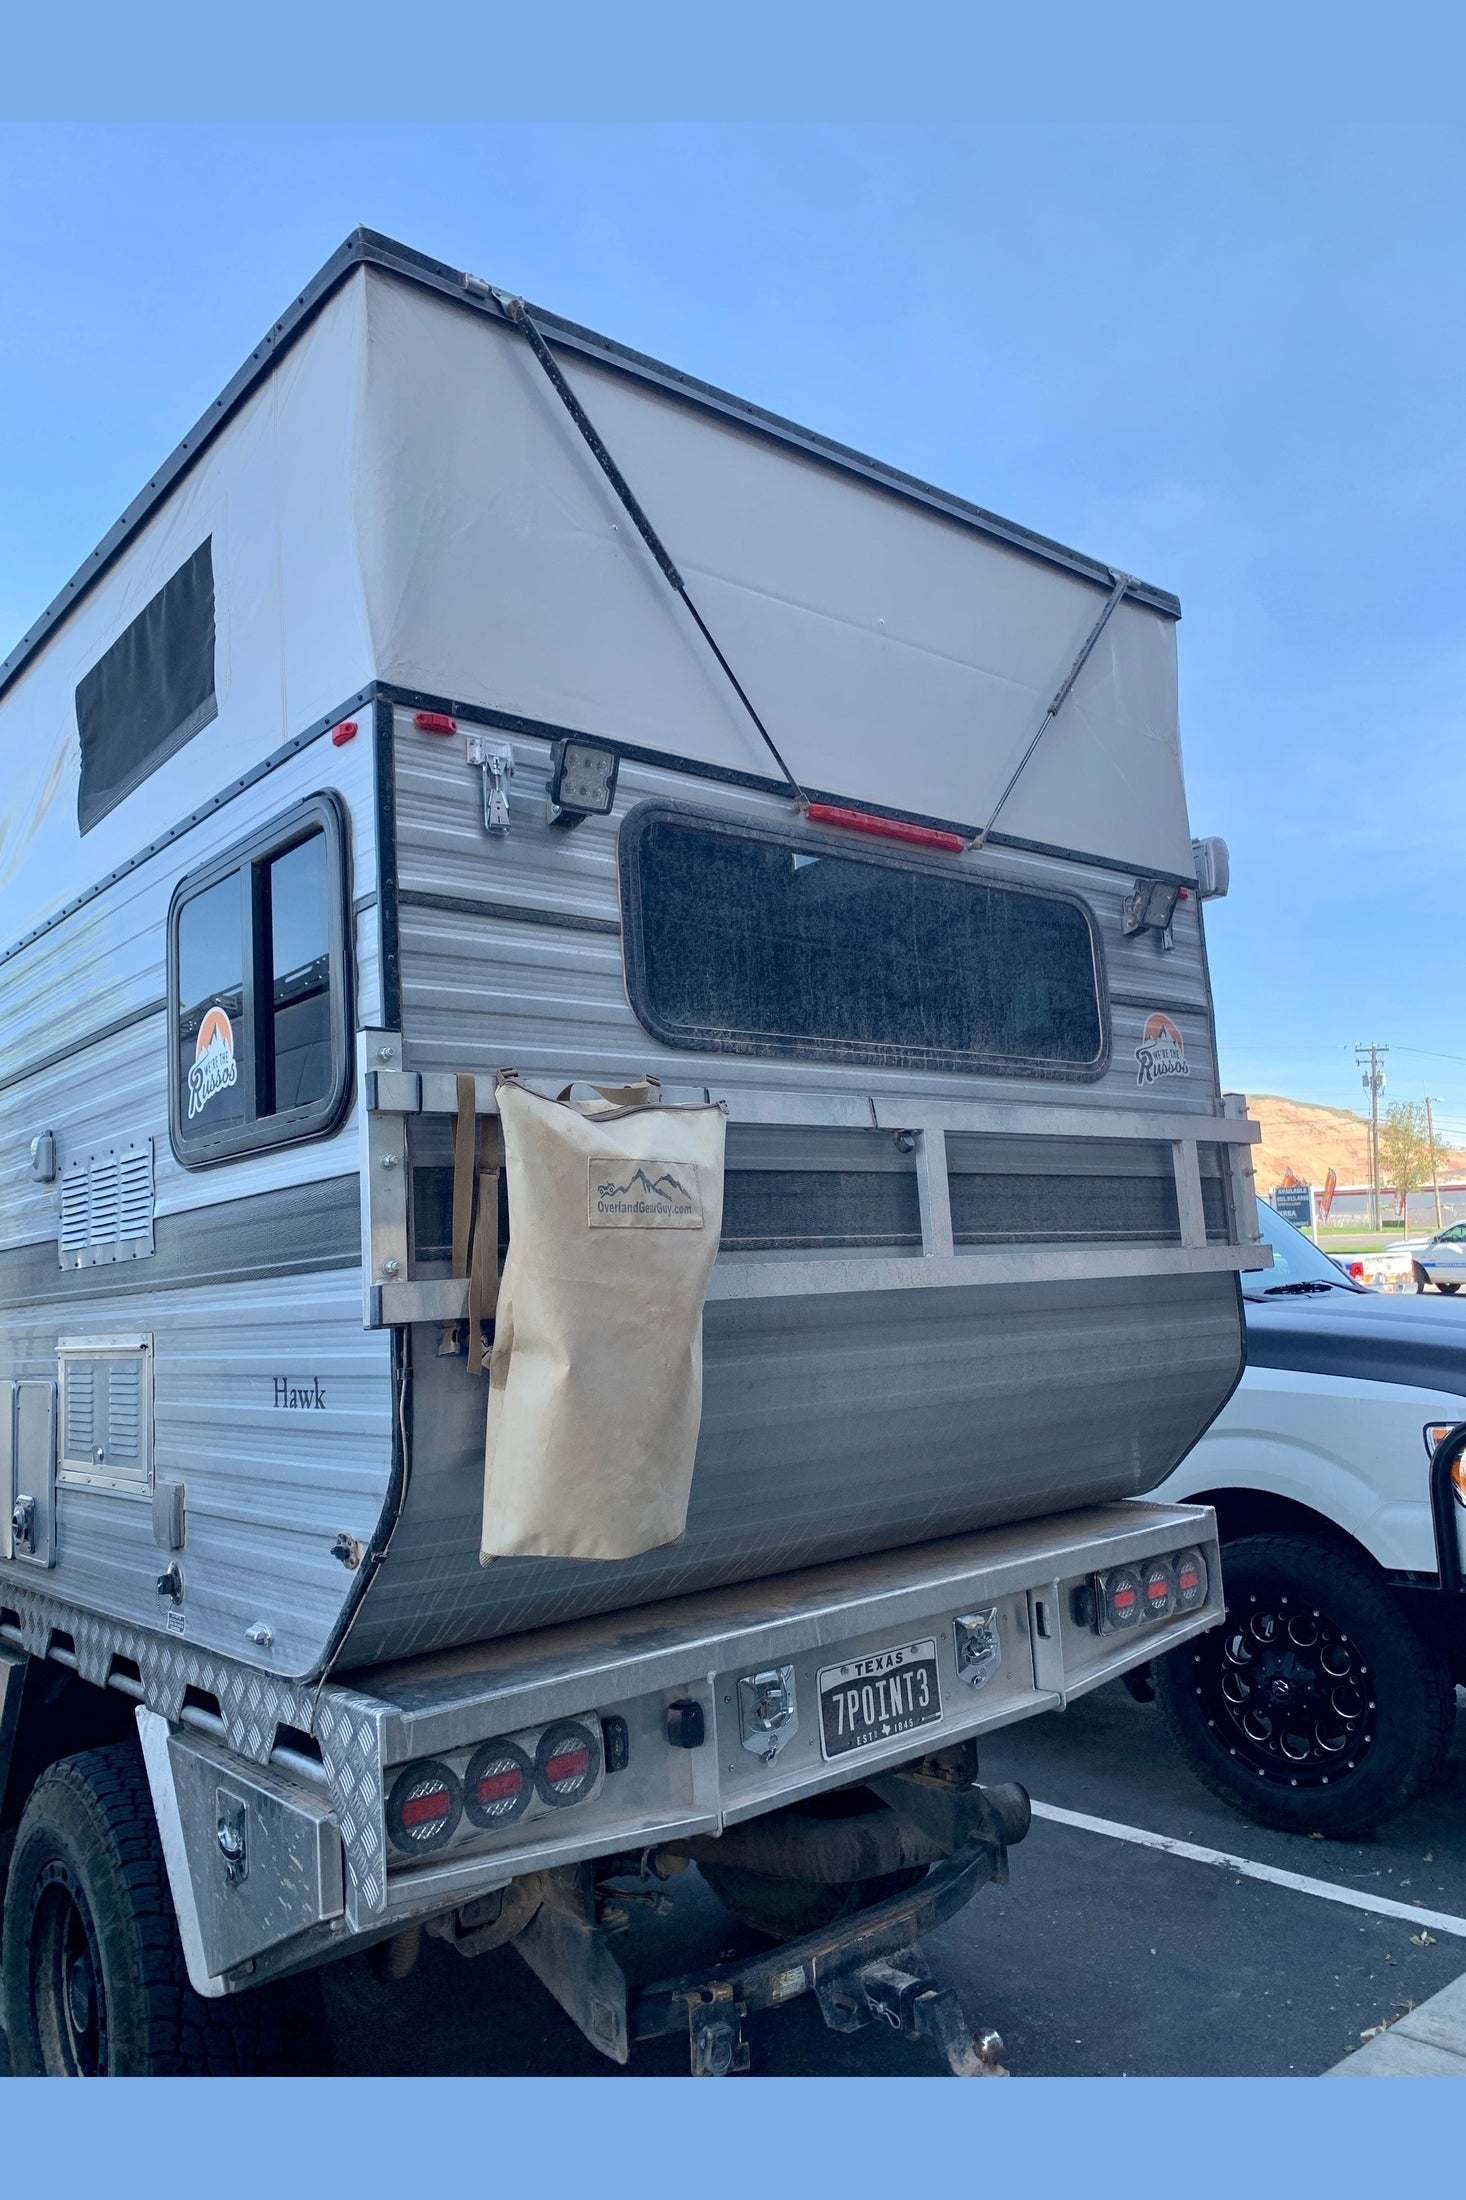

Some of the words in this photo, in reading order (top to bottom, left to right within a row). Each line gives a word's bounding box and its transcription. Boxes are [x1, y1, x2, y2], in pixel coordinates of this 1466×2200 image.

[218, 1051, 228, 1065] THE
[1136, 1042, 1188, 1084] Russos
[1170, 1049, 1180, 1060] THE
[190, 1056, 235, 1116] Russos
[597, 1201, 692, 1216] OverlandGearGuy.com
[273, 1375, 326, 1409] Hawk
[855, 1652, 903, 1676] TEXAS
[832, 1668, 929, 1735] 7POINT3
[894, 1718, 914, 1732] 1845
